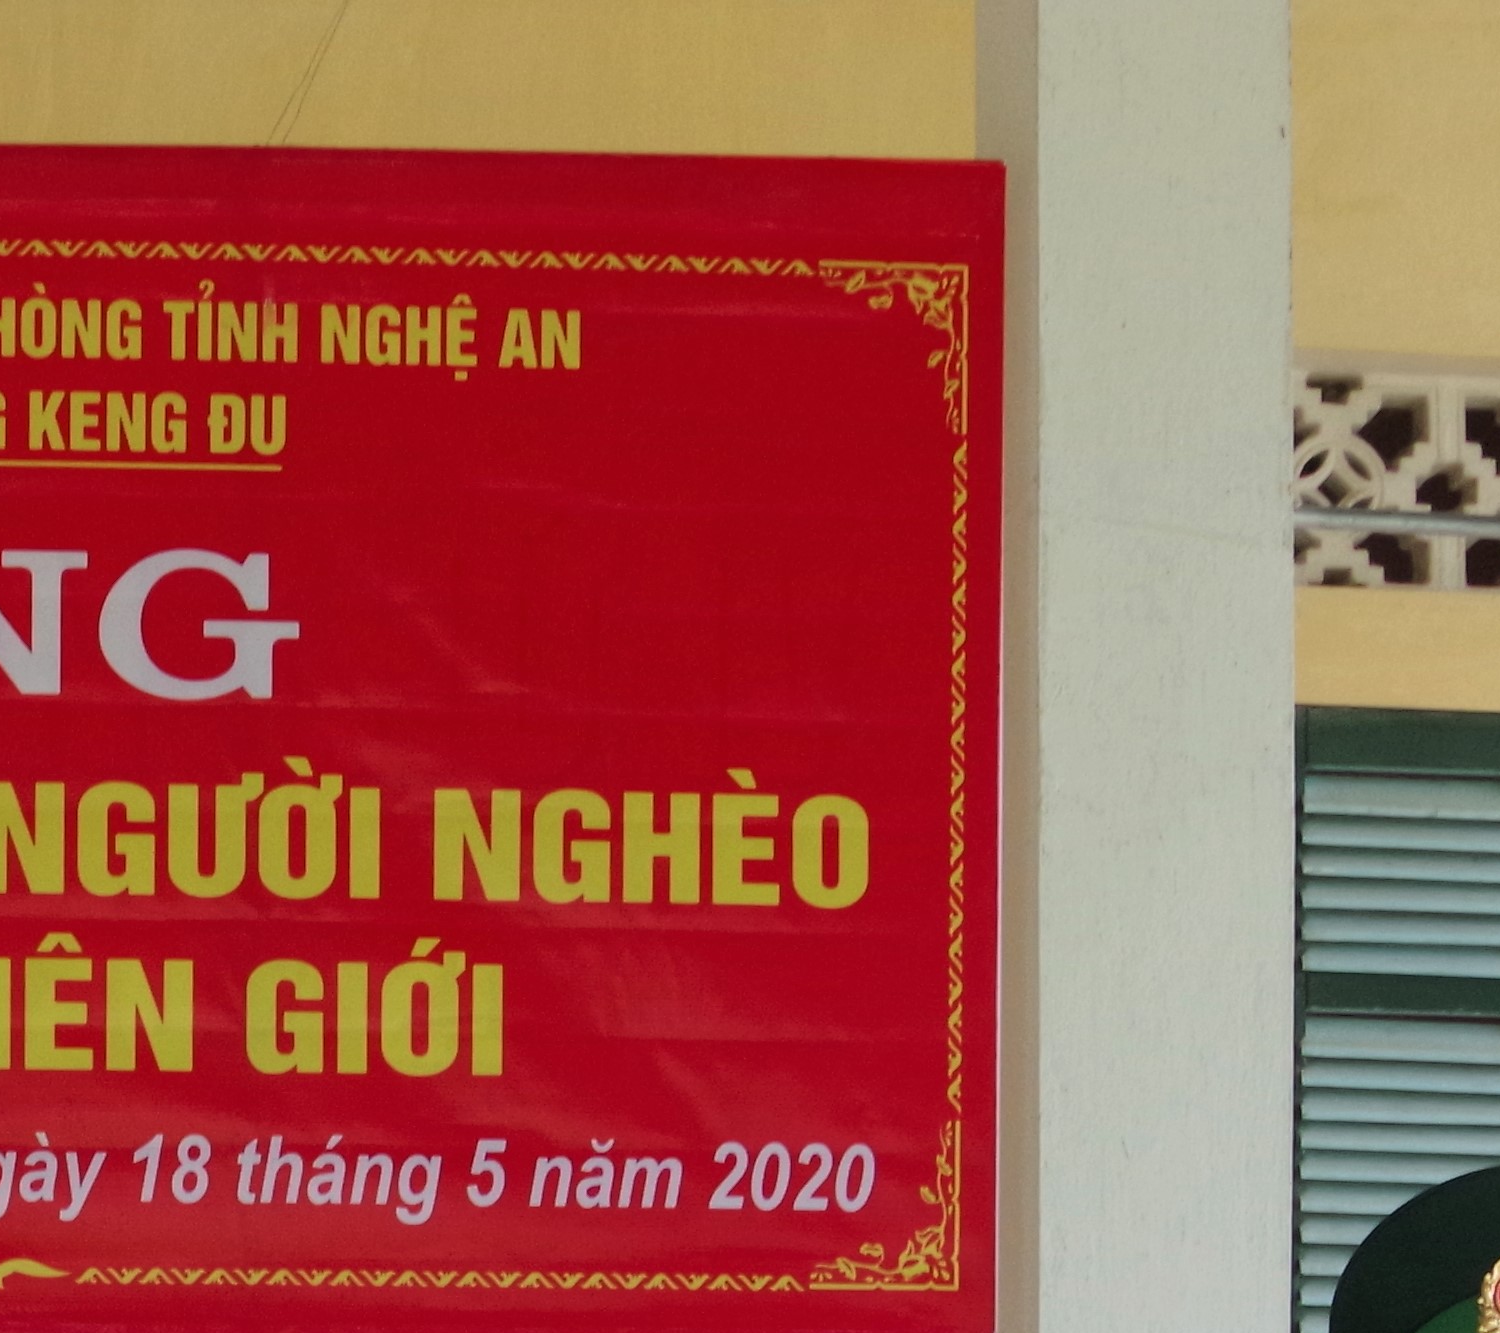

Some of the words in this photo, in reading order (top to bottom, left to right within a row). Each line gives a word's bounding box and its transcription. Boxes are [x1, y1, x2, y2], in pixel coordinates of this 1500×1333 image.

[164, 281, 297, 362] TỈNH
[321, 291, 477, 380] NGHỆ
[499, 310, 580, 368] AN
[29, 391, 186, 452] KENG
[208, 395, 286, 454] ĐU
[434, 769, 868, 908] NGHÈO
[246, 938, 503, 1076] GIỚI
[134, 1134, 210, 1204] 18
[237, 1135, 441, 1225] tháng
[467, 1140, 506, 1207] 5
[530, 1139, 682, 1208] năm
[709, 1142, 874, 1212] 2020
